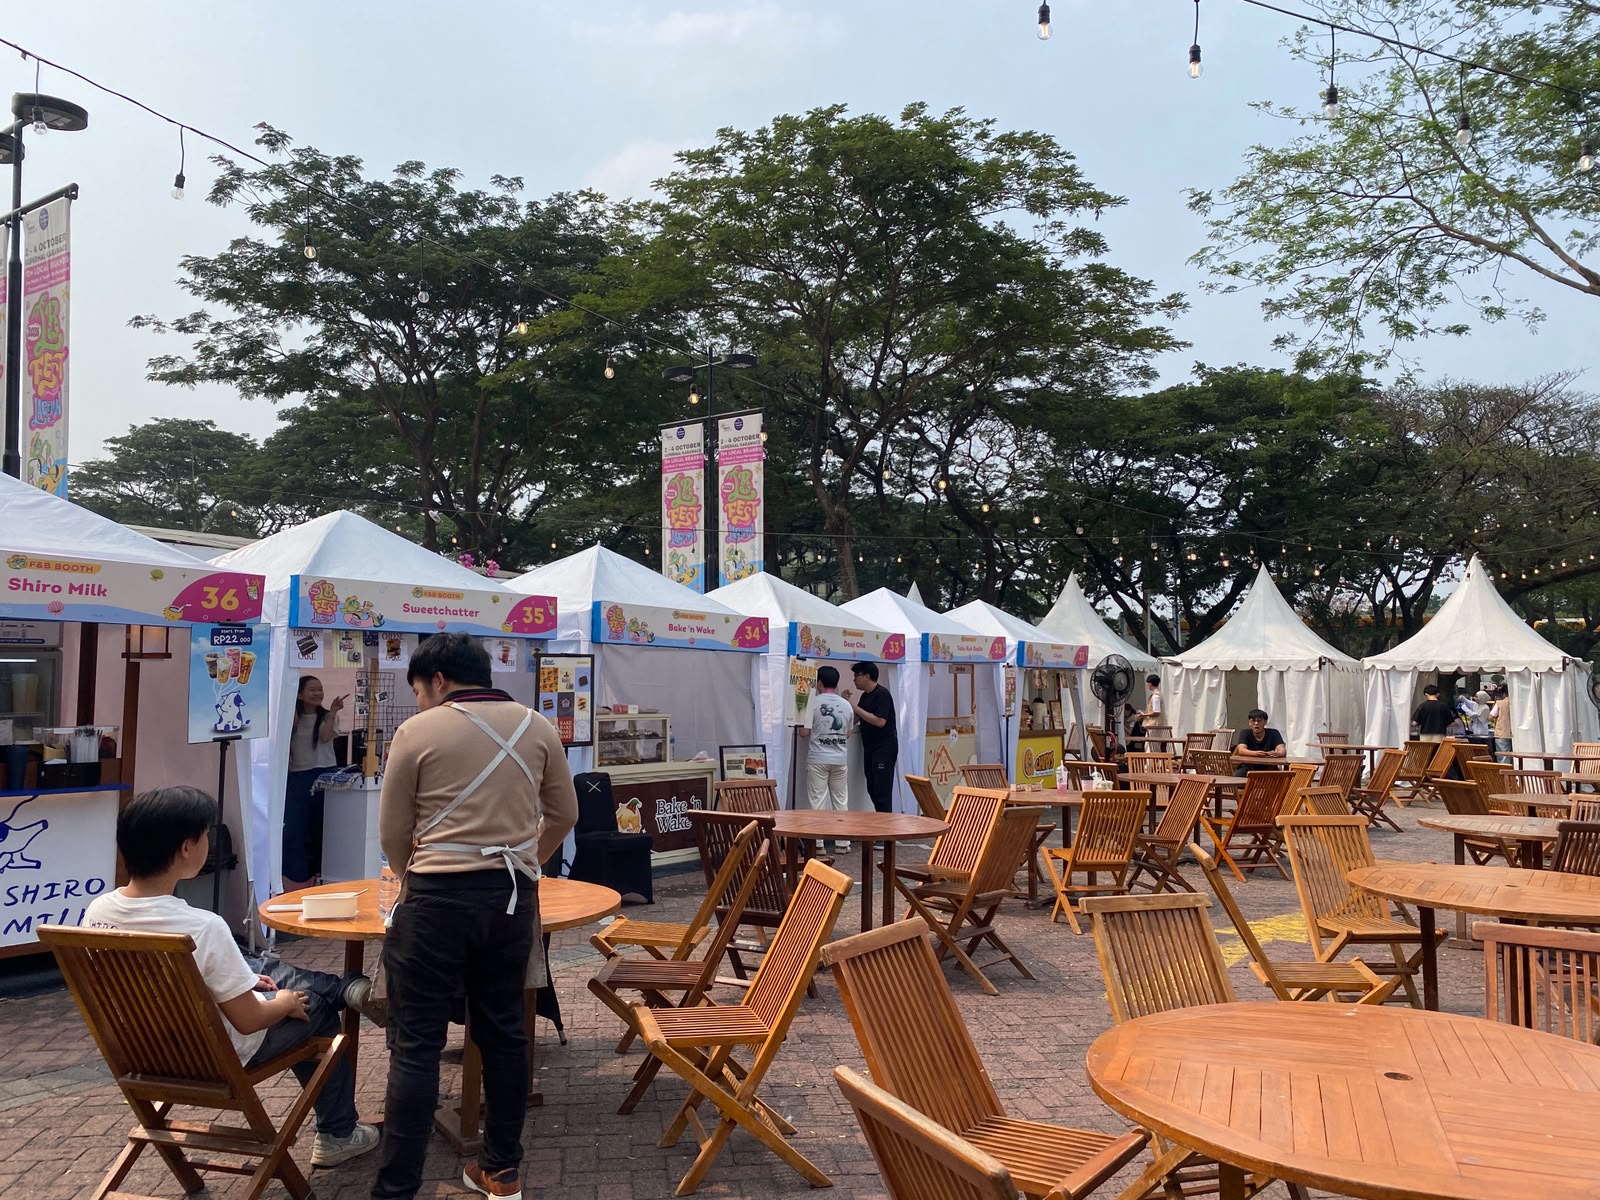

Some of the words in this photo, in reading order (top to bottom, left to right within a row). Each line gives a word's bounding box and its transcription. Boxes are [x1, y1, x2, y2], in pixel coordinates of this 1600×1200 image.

[38, 233, 67, 252] OCTOBER
[676, 442, 701, 450] OCTOBER
[733, 433, 760, 442] OCTOBER
[668, 506, 702, 528] FEST
[725, 500, 760, 525] FEST
[29, 561, 51, 569] F&B
[55, 563, 93, 573] BOOTH
[8, 577, 62, 594] Shiro
[68, 582, 107, 597] Milk
[201, 586, 239, 610] 36
[403, 603, 479, 617] Sweetchatter
[522, 607, 544, 624] 35
[668, 624, 686, 632] Bake
[696, 626, 715, 634] Wake
[745, 626, 760, 640] 34
[889, 641, 899, 653] 33
[656, 796, 688, 816] Bake
[655, 814, 692, 833] Wake
[4, 878, 105, 906] SHIRO
